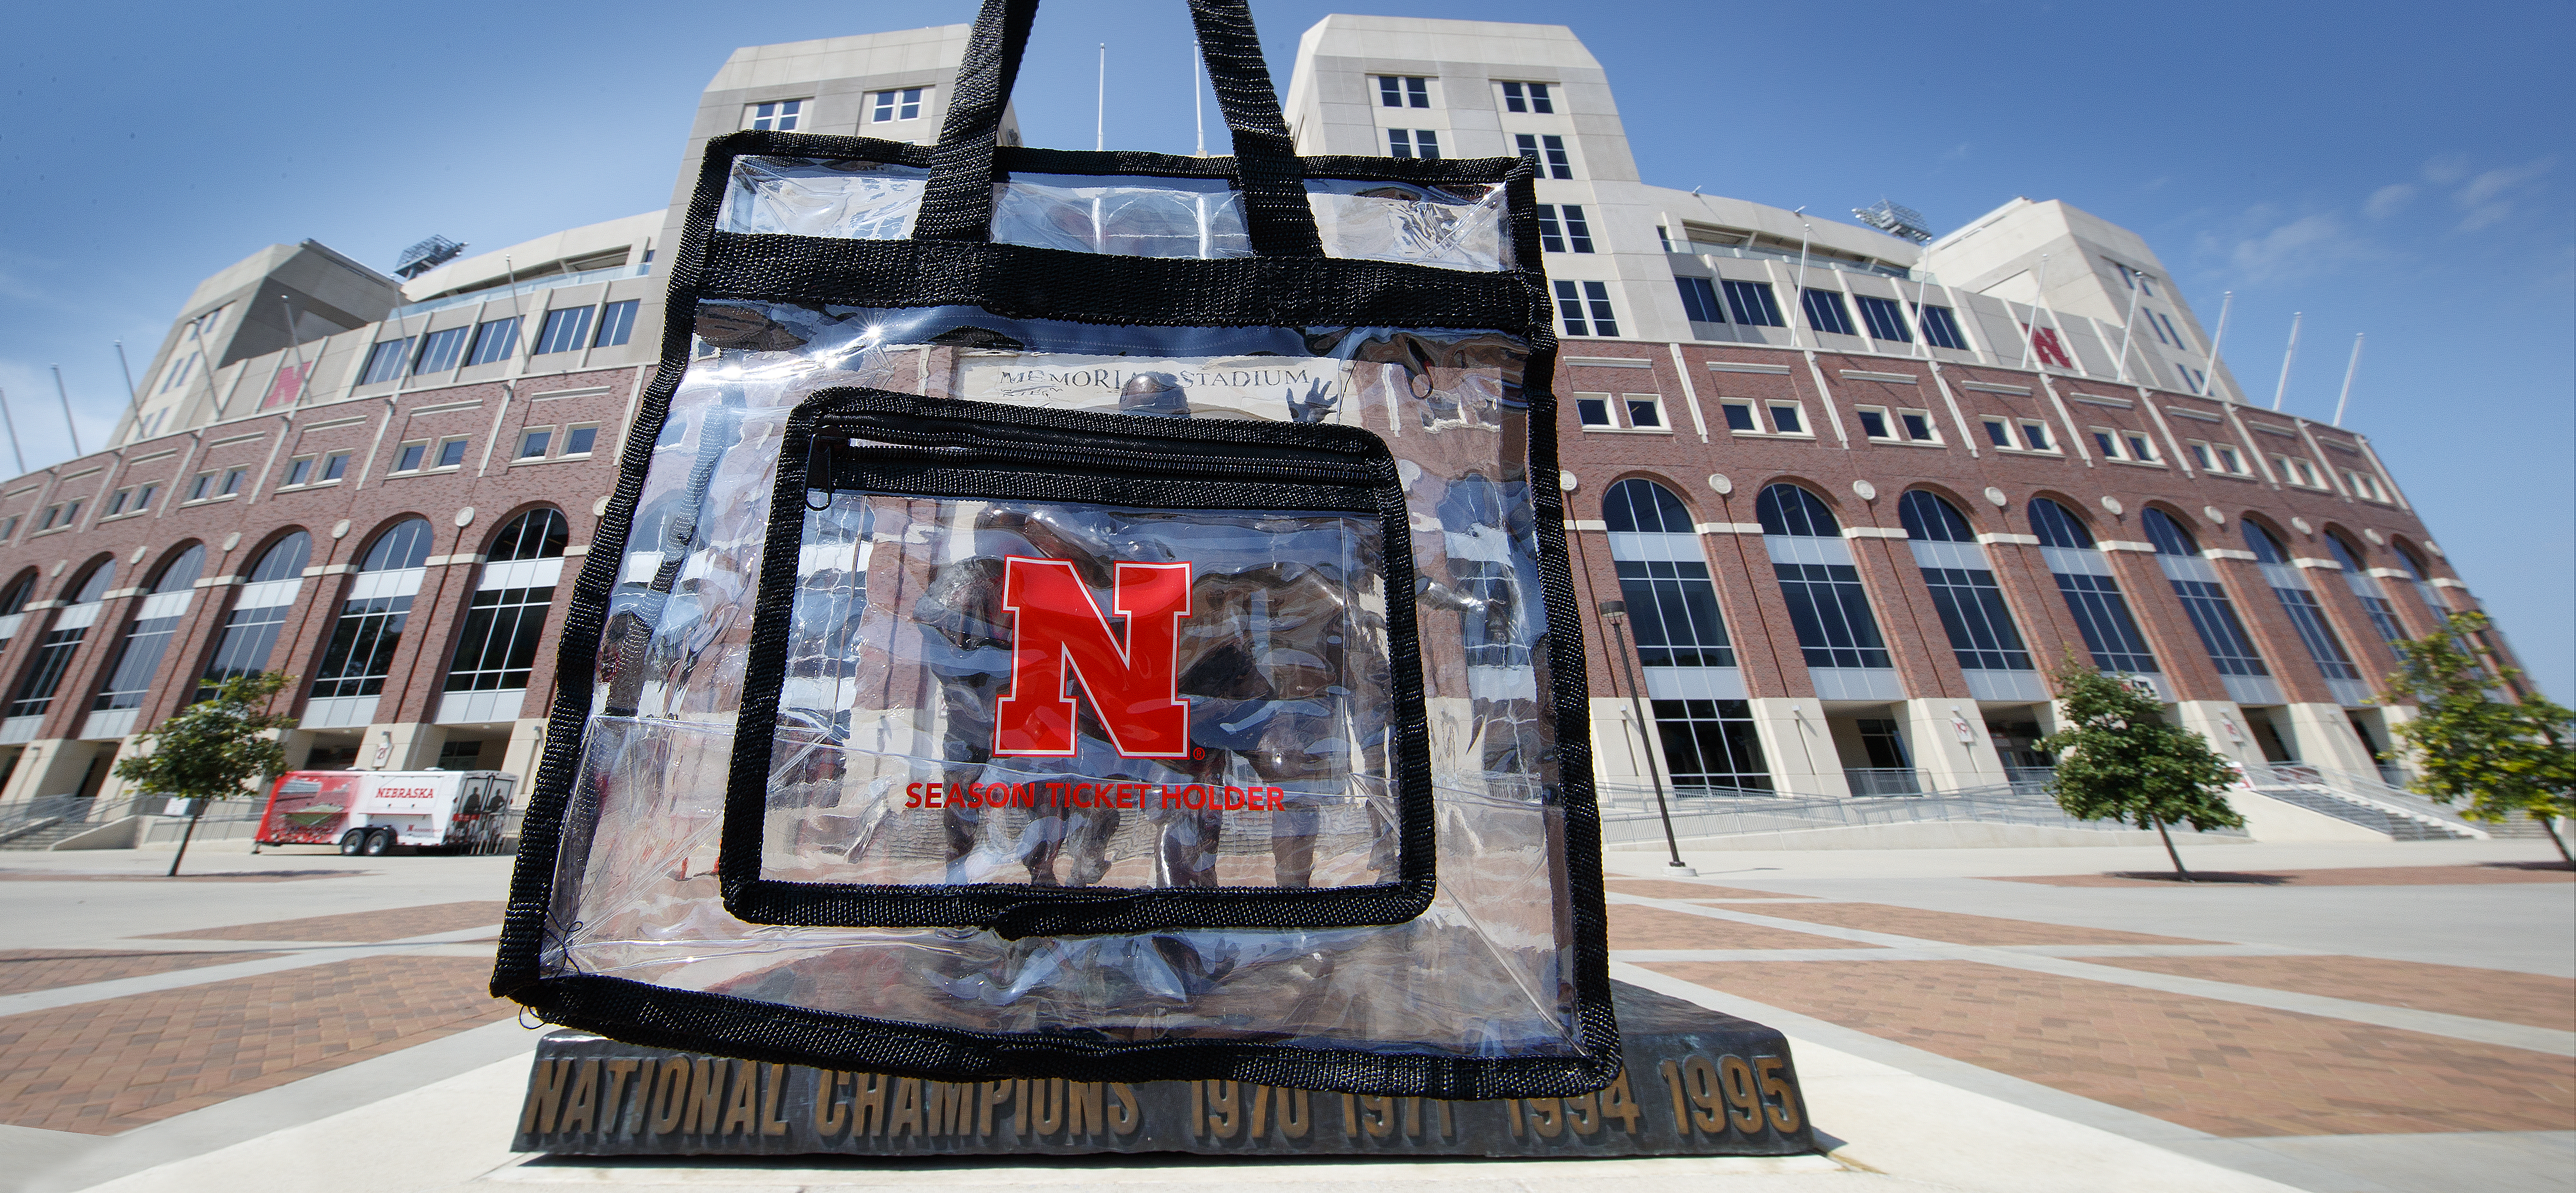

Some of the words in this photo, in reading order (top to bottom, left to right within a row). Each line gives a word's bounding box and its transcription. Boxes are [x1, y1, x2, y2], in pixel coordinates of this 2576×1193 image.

[999, 369, 1138, 390] MEMORI
[1180, 369, 1310, 388] STADIUM
[992, 554, 1193, 760] N
[375, 787, 433, 798] NEBRASKA
[905, 782, 1034, 808] SEASON
[1046, 783, 1151, 808] TICKET
[1161, 784, 1286, 811] HOLDER
[522, 1055, 789, 1136] NATIONAL
[814, 1069, 1140, 1137] CHAMPIONS
[1660, 1055, 1800, 1135] 1995
